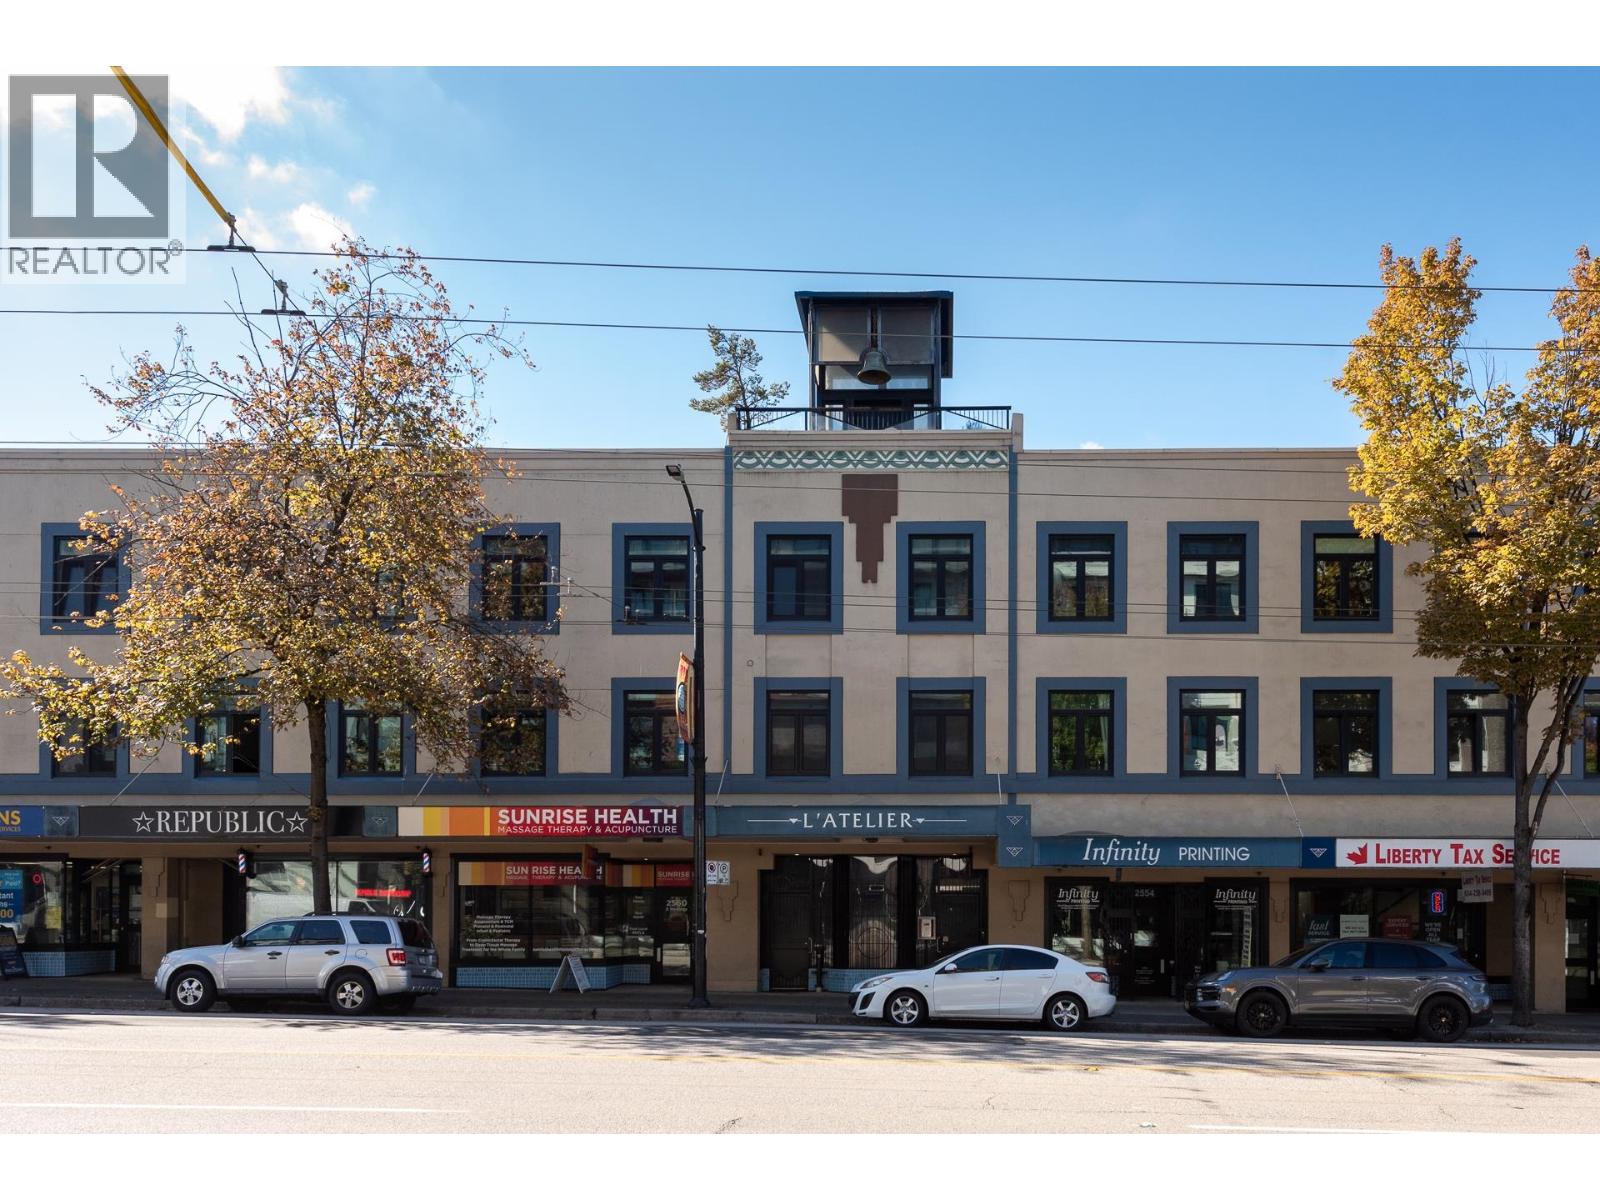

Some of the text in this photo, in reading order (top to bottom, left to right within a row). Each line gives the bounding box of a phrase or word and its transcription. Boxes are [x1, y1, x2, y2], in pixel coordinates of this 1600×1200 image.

[156, 811, 285, 833] REPUBLIC
[498, 808, 677, 825] SUNRISE HEALTH
[803, 812, 912, 829] L'ATELIER
[498, 825, 677, 834] MASSAGE THERAPY & ACUPUNCTURE
[1082, 838, 1250, 865] Infinity PRINTING
[1375, 843, 1442, 864] LIBERTY
[1450, 843, 1483, 864] TAX
[1058, 888, 1099, 901] Infinity
[1215, 888, 1257, 901] Infinity
